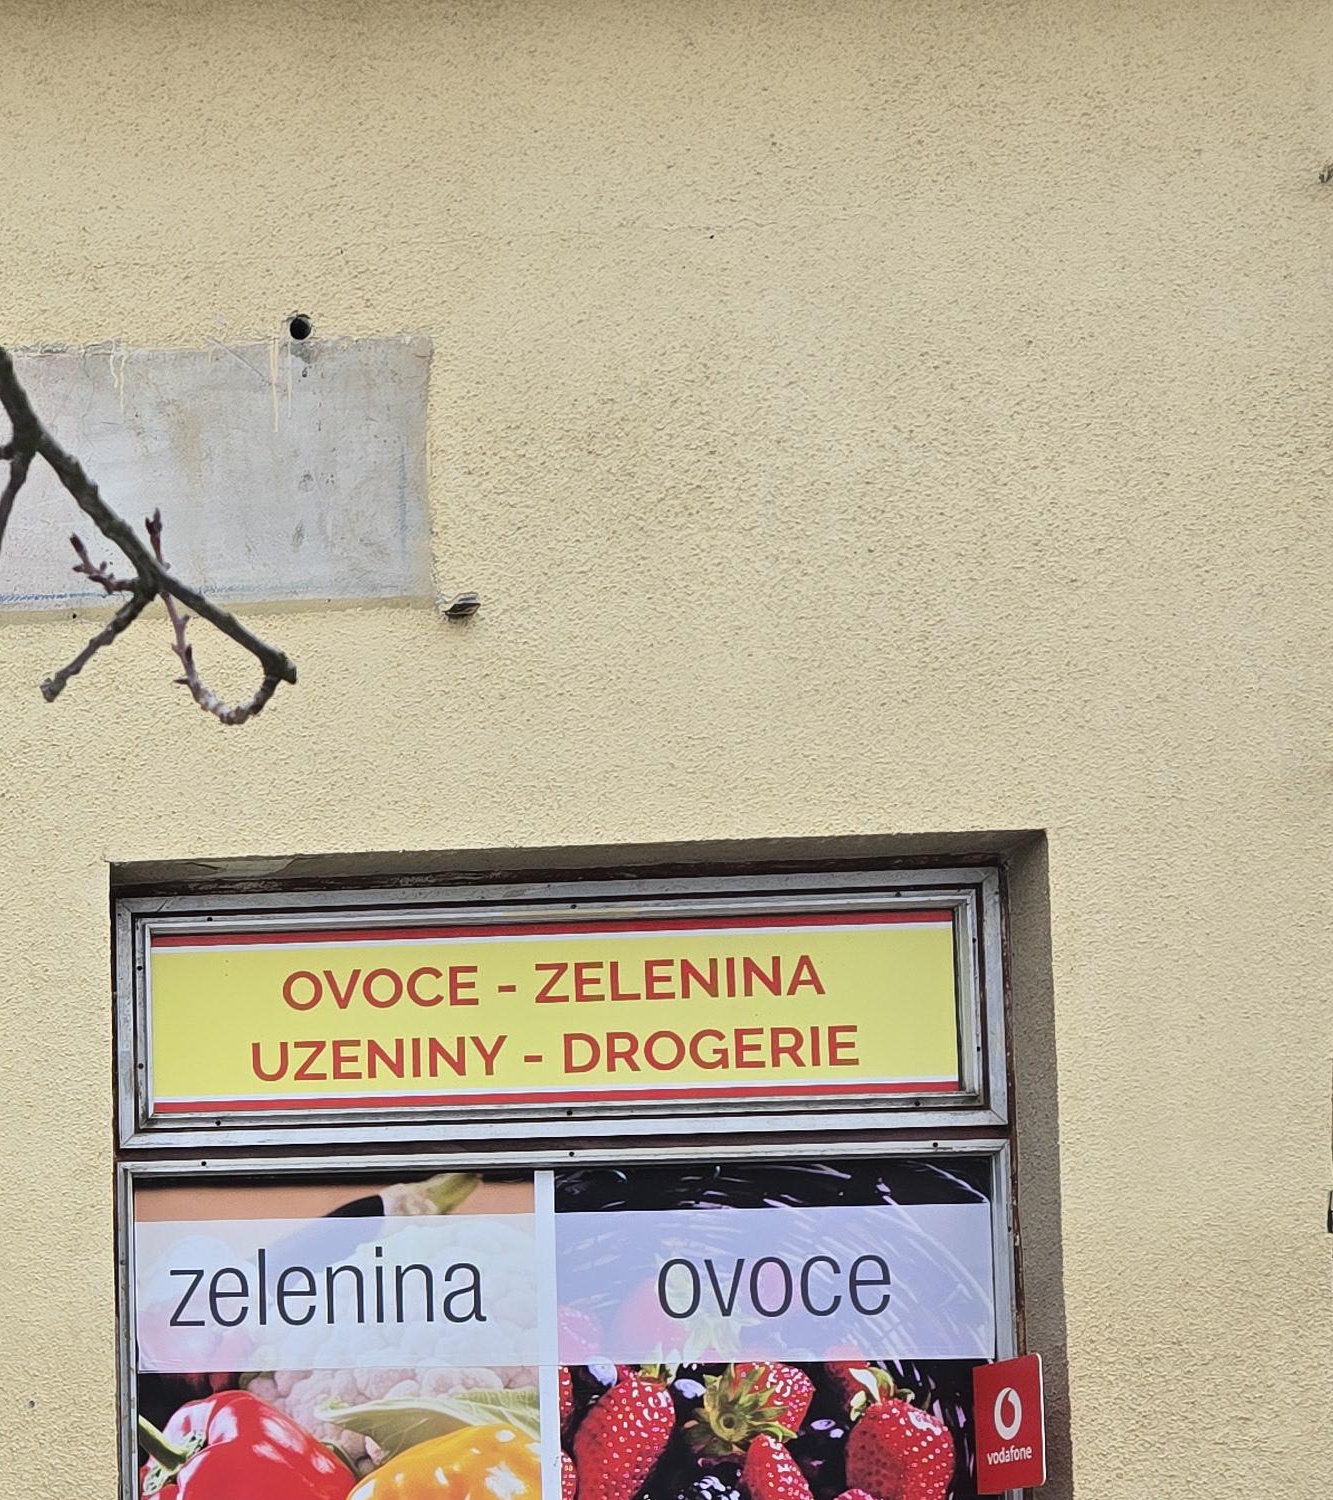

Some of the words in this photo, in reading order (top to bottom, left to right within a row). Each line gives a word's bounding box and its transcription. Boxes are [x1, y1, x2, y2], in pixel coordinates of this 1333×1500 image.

[281, 964, 480, 1012] OVOCE
[534, 954, 827, 1004] ZELENINA
[249, 1034, 509, 1083] UZENINY
[561, 1024, 861, 1076] DROGERIE
[168, 1245, 487, 1330] zelenina
[656, 1252, 892, 1321] ovoce
[986, 1445, 1033, 1466] vodafone
